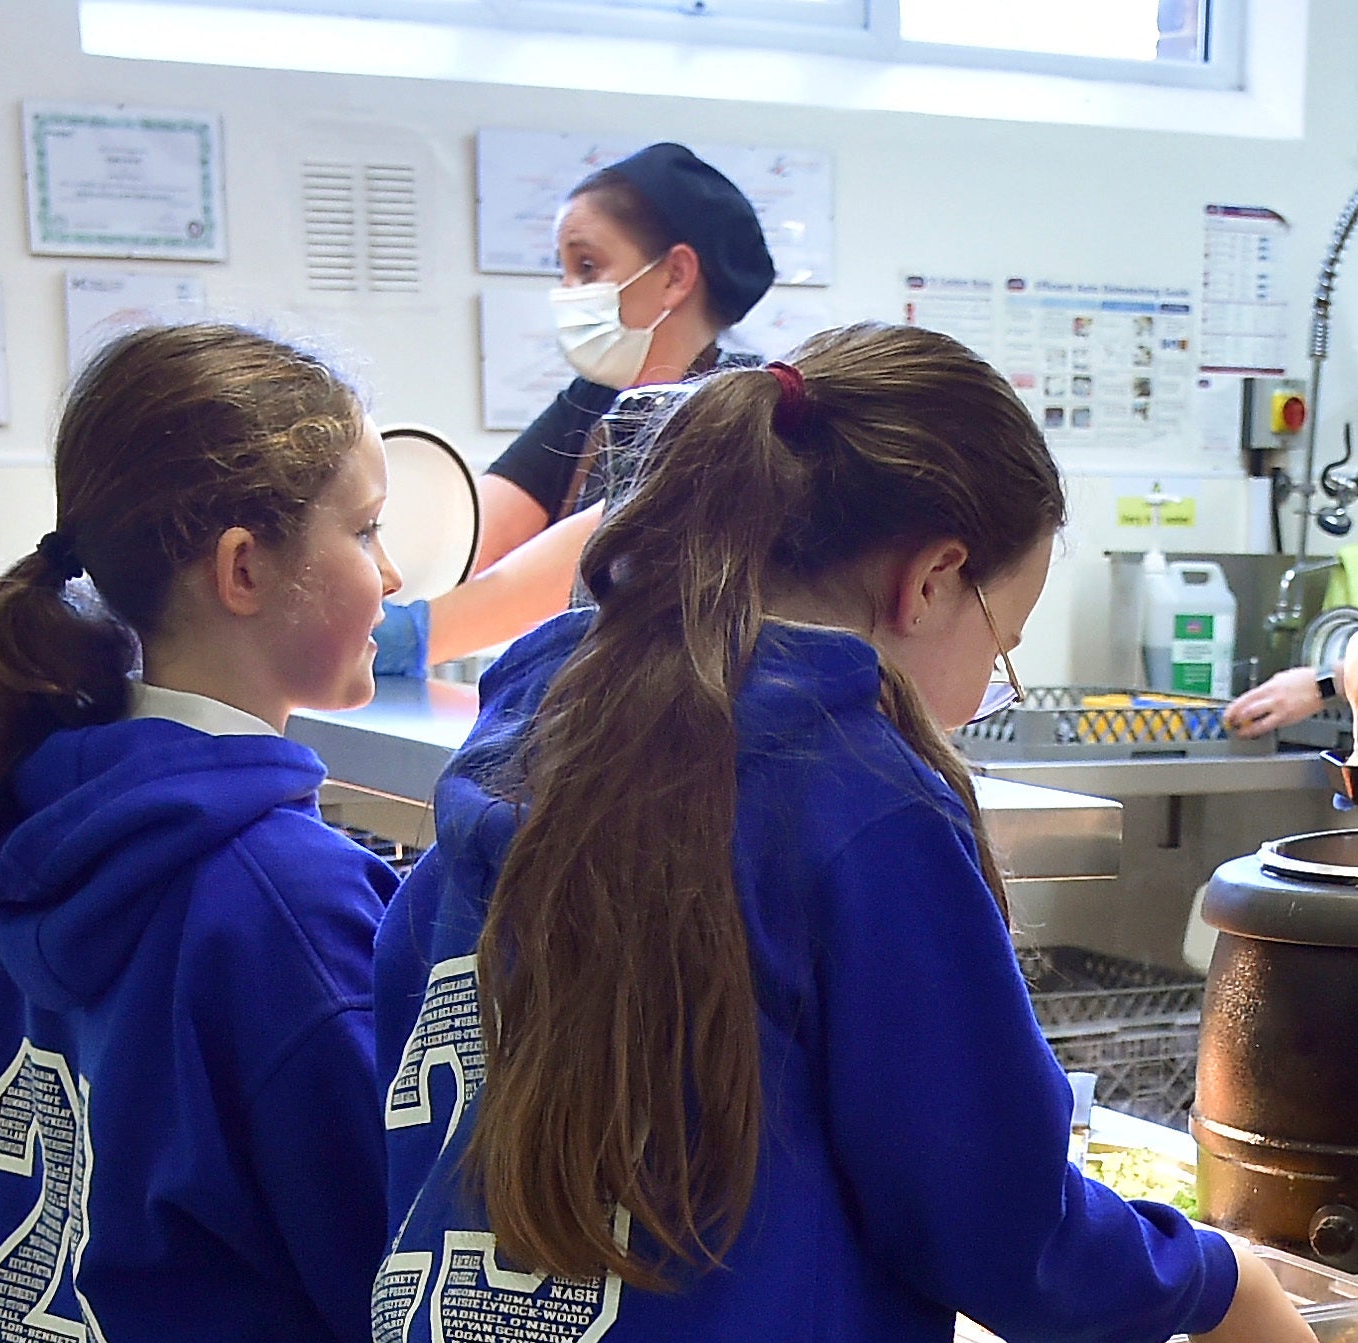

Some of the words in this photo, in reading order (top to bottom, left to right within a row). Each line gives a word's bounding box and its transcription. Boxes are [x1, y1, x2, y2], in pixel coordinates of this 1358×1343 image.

[550, 1285, 599, 1304] NASH
[443, 1308, 507, 1325] GABRIEL
[510, 1317, 582, 1337] O'NEILL
[446, 1328, 496, 1343] LOGAN
